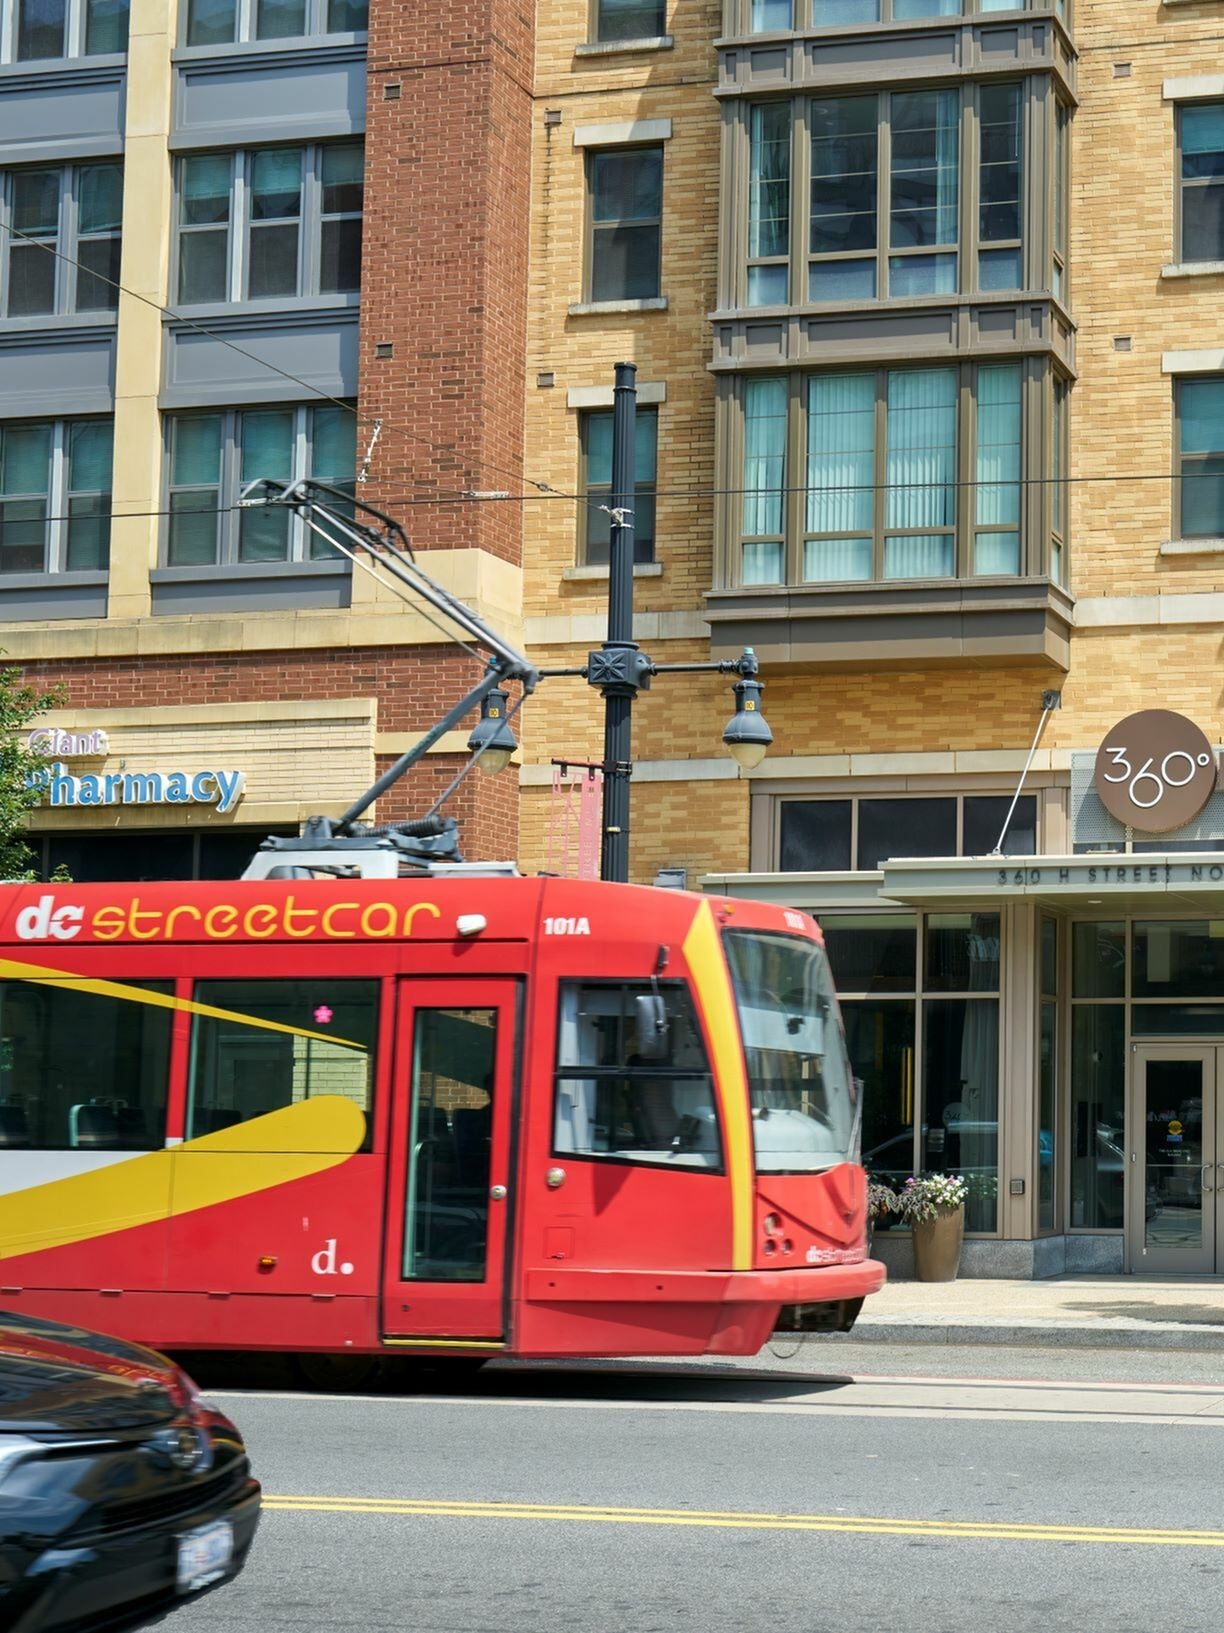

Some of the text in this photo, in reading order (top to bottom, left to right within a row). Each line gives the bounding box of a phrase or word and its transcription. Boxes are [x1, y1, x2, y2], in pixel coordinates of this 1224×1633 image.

[28, 728, 106, 755] Giant
[998, 869, 1040, 885] 360
[1059, 869, 1070, 883] H
[1088, 866, 1173, 883] STREET
[15, 895, 441, 940] dc streetcar
[543, 917, 591, 935] 101A
[311, 1238, 354, 1275] d.
